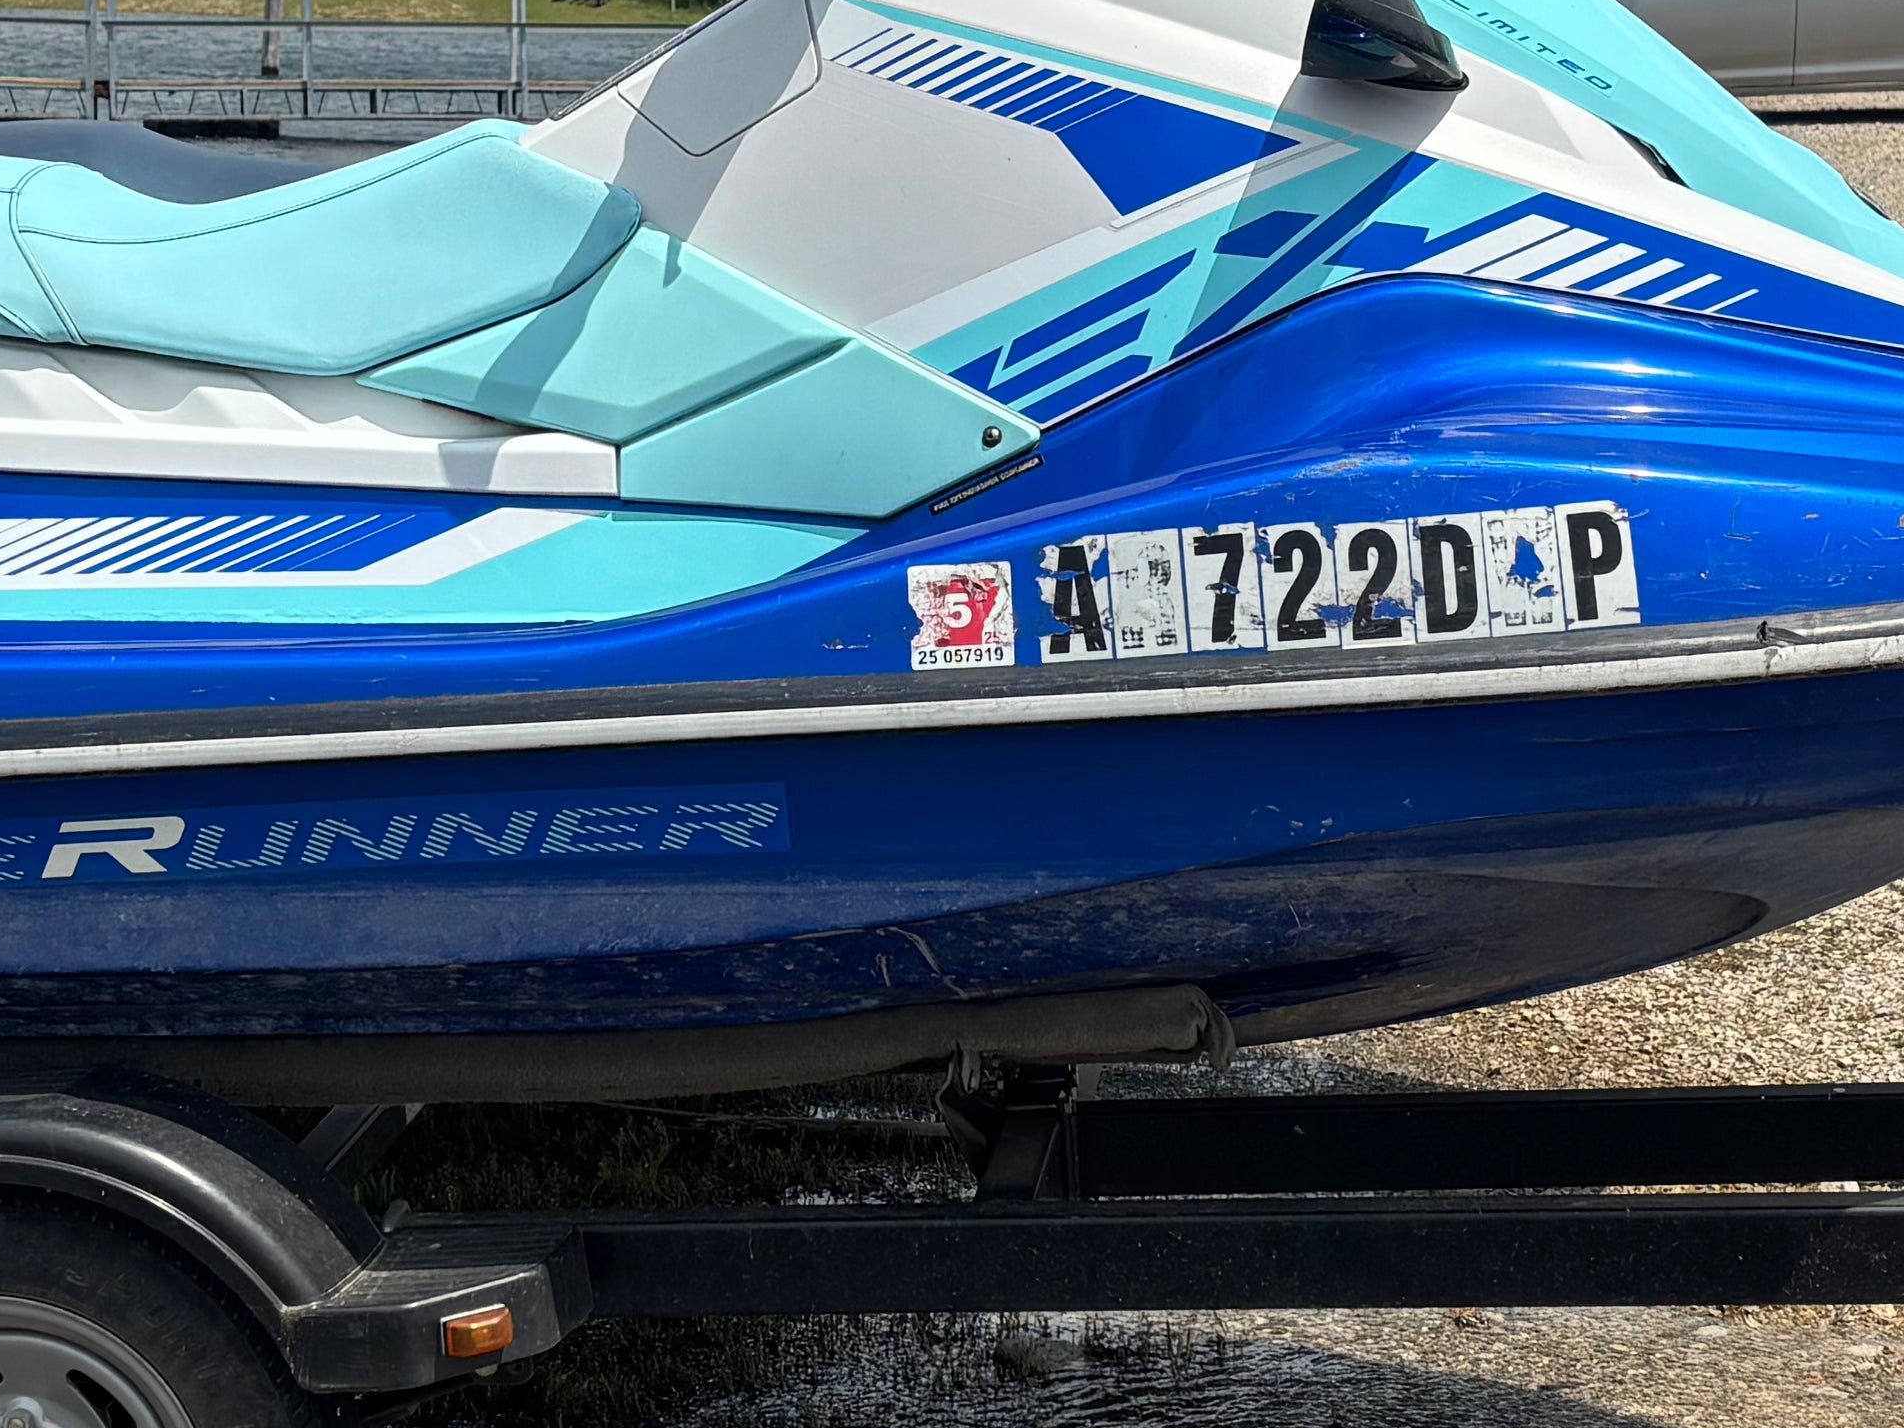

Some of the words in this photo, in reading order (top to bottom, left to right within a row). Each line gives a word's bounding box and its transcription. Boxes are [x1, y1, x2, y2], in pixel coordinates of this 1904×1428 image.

[943, 592, 972, 628] 5
[918, 650, 938, 665] 25
[943, 647, 1004, 664] 057919
